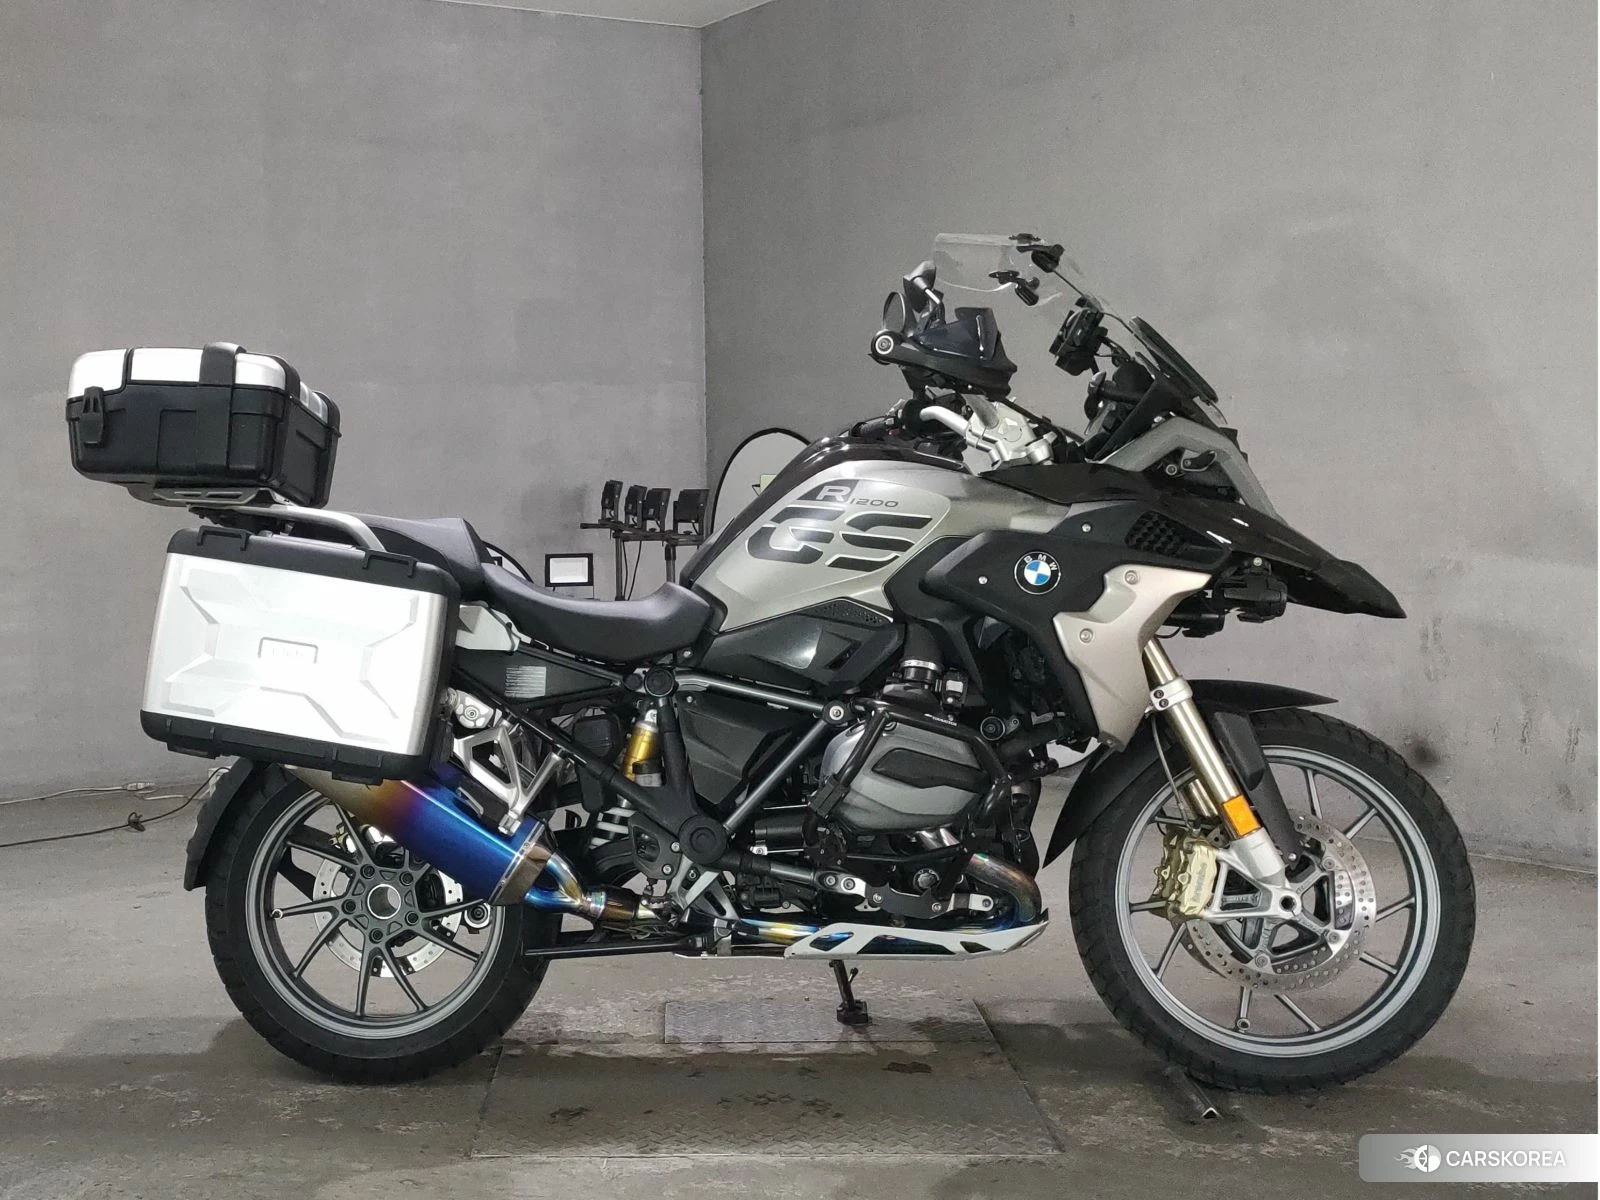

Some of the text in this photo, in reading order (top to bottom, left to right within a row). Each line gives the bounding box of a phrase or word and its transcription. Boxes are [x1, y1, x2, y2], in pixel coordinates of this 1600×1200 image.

[815, 485, 900, 508] R 1200
[746, 504, 933, 572] GS
[1024, 553, 1058, 571] BMW
